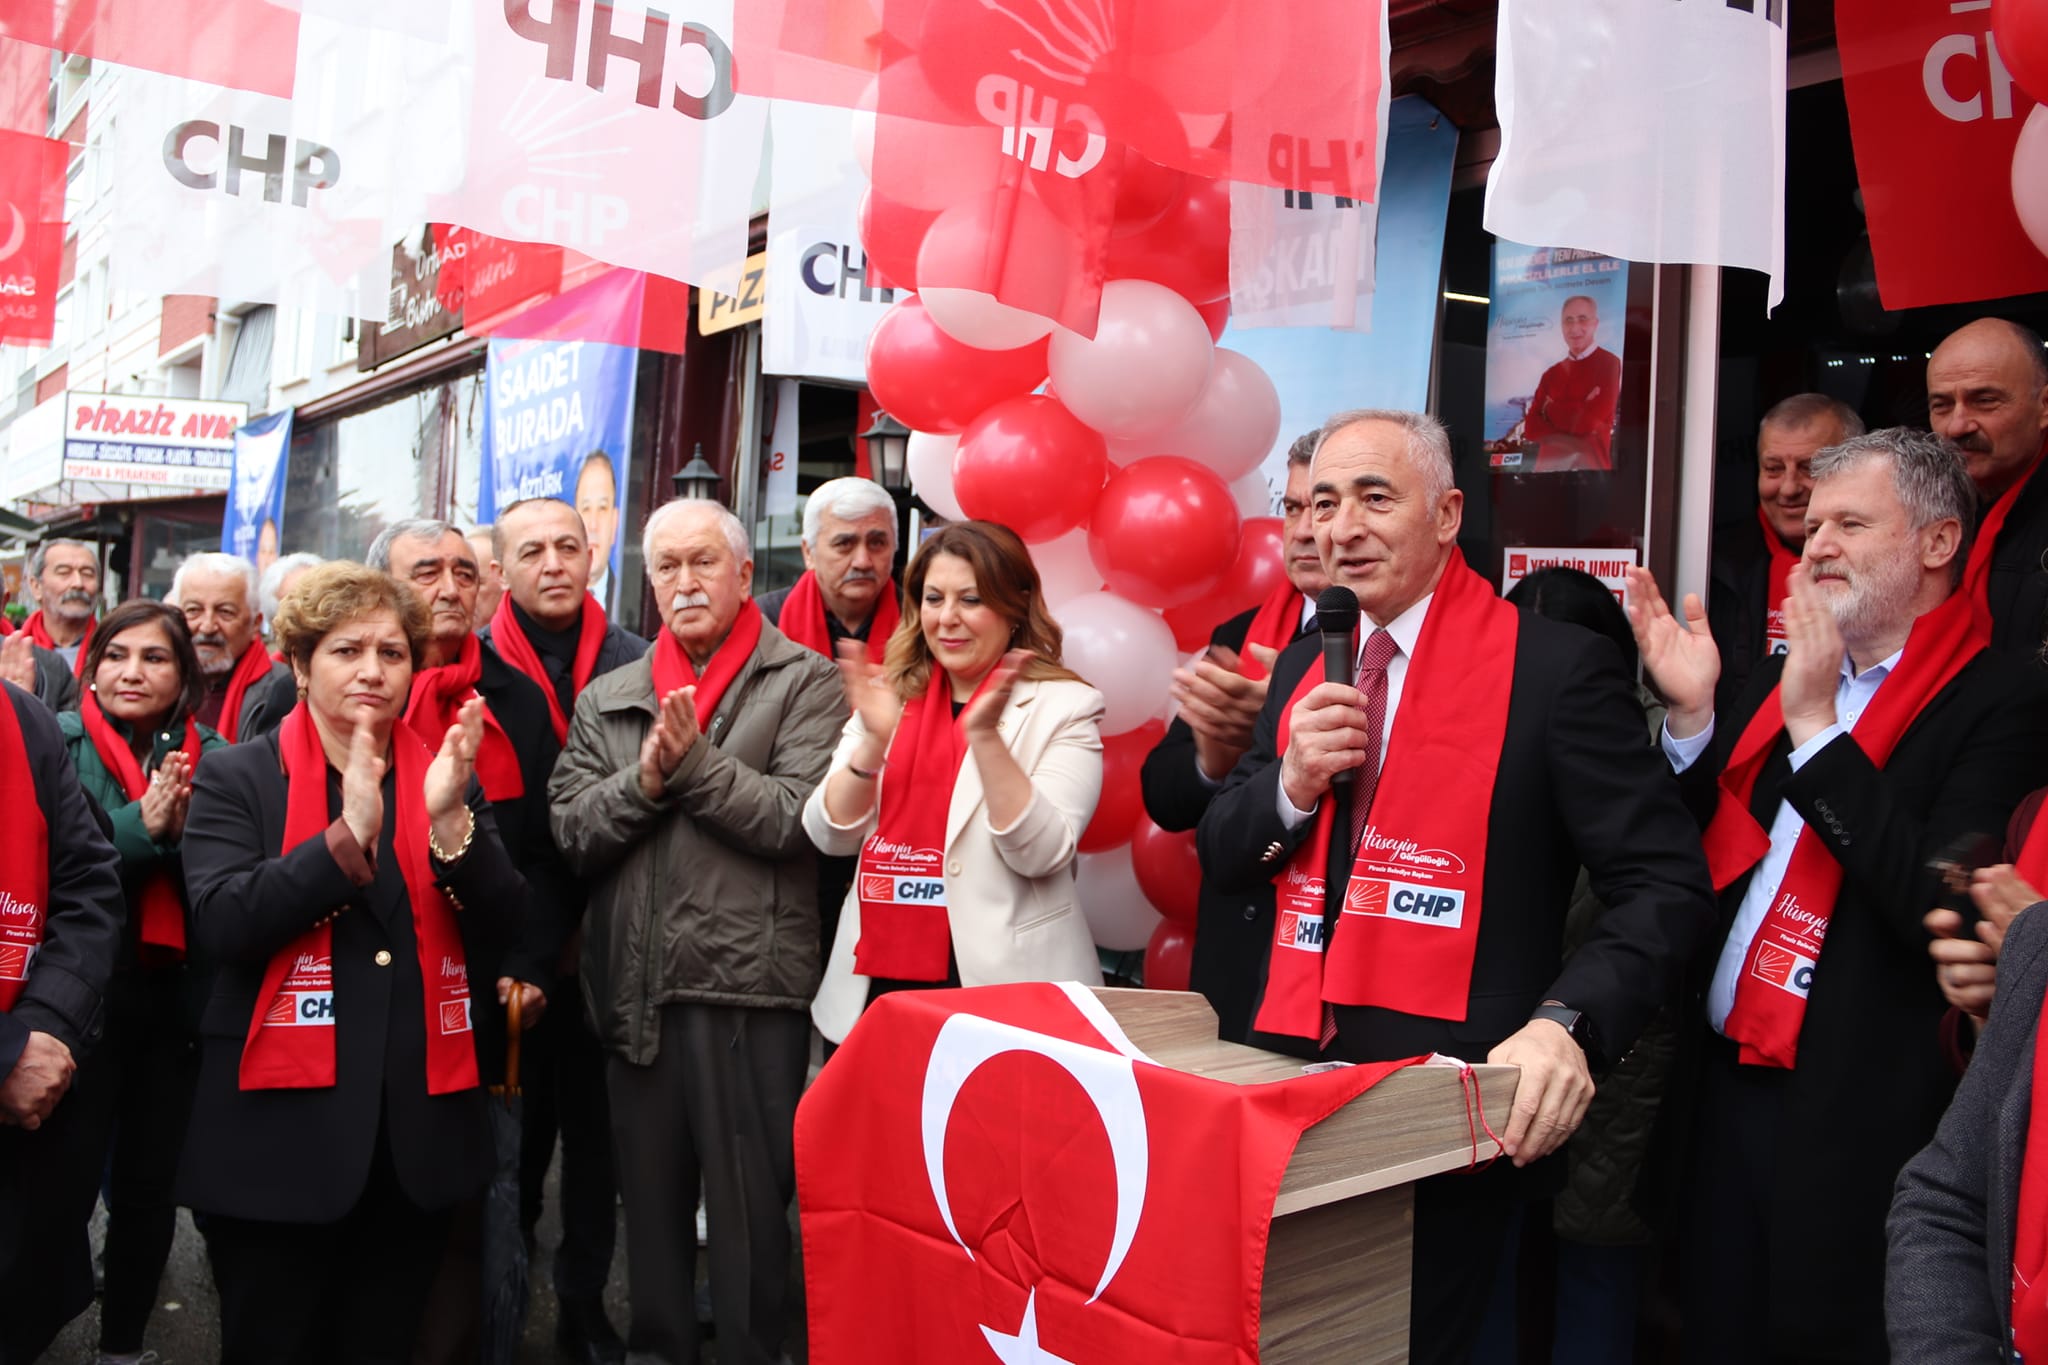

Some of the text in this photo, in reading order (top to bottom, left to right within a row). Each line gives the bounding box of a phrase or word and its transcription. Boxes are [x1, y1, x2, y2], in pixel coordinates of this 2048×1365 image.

[162, 119, 341, 208] CHP
[501, 184, 629, 247] CHP
[500, 338, 584, 409] SAADET
[75, 399, 176, 436] PİRAZİZ
[495, 390, 584, 458] BURADA
[1504, 454, 1521, 464] CHP
[1589, 560, 1629, 578] UMUT
[867, 835, 912, 862] Hüseyin
[1360, 824, 1418, 862] Hüseyin
[1399, 852, 1450, 867] Görgülüoğlu
[898, 881, 945, 899] CHP
[1393, 889, 1456, 918] CHP
[301, 998, 336, 1018] CH
